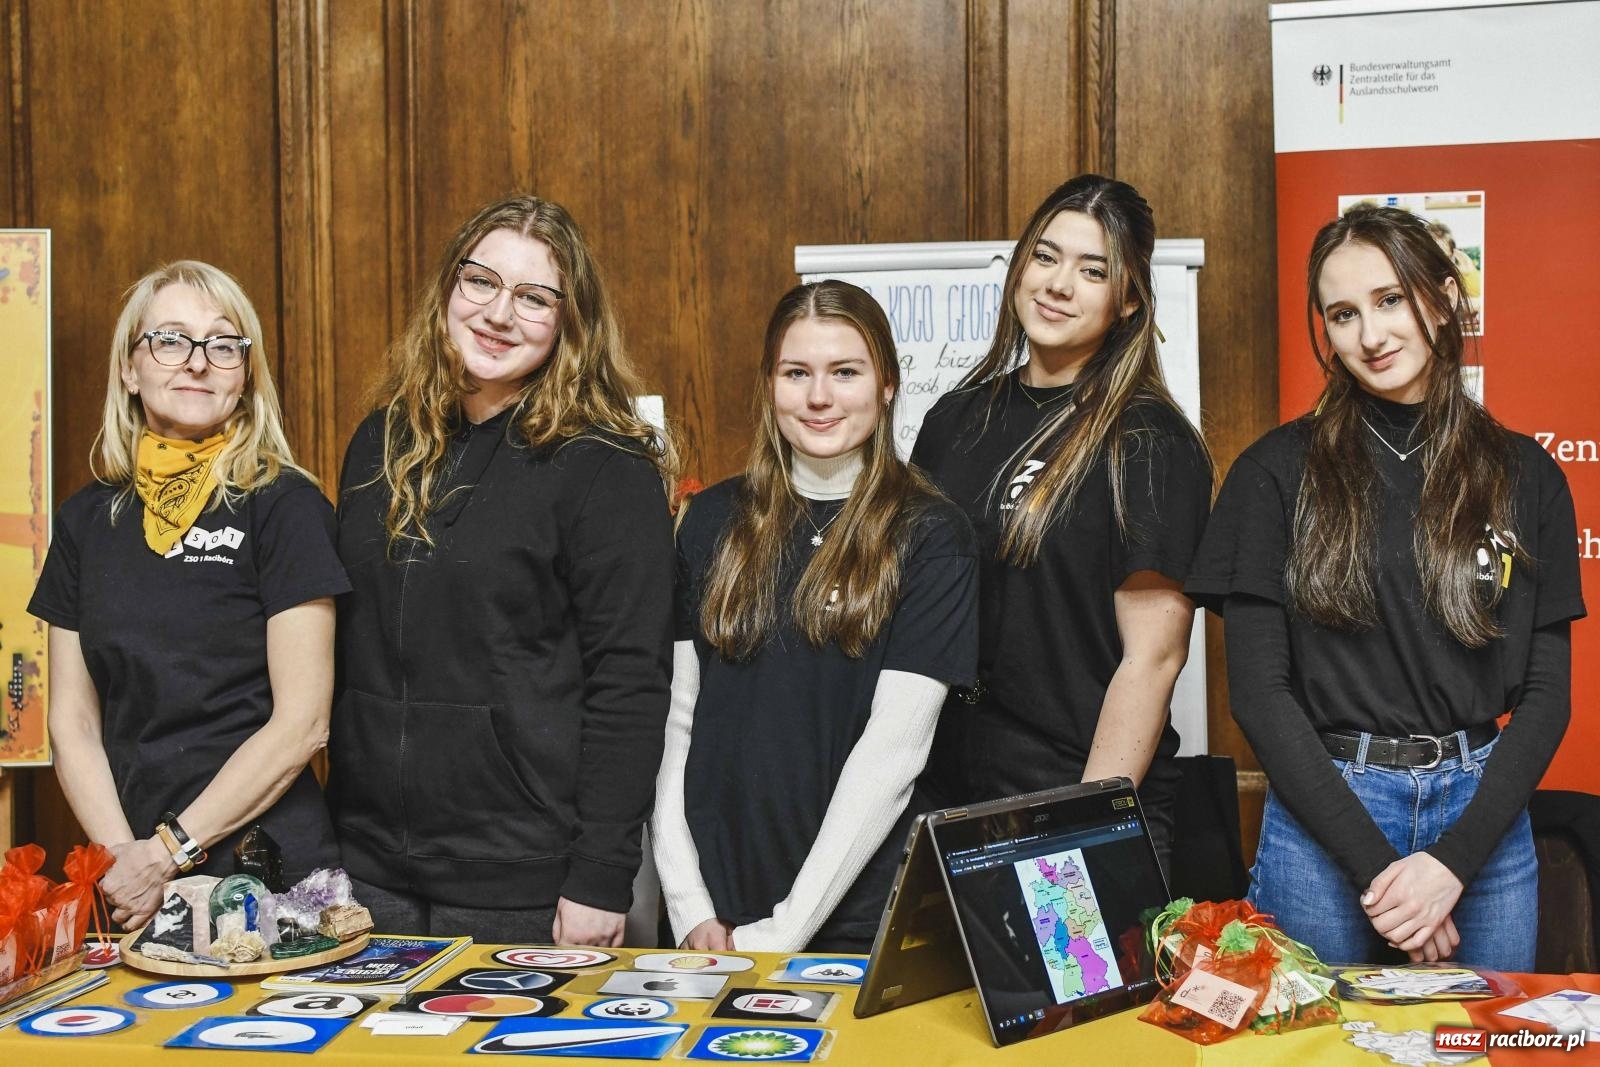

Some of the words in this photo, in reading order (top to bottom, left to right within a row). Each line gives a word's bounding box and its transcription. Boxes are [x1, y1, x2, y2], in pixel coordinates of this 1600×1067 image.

[1349, 59, 1451, 72] Bundesverwaltungsamt
[1349, 73, 1403, 85] Zentralstelle
[1406, 72, 1418, 82] für
[1420, 70, 1436, 80] das
[1349, 84, 1439, 96] Auslandsschulwesen
[888, 284, 934, 343] KOGO
[947, 283, 1002, 343] GEOGR
[1534, 432, 1600, 462] Zen
[183, 554, 199, 563] ZSO
